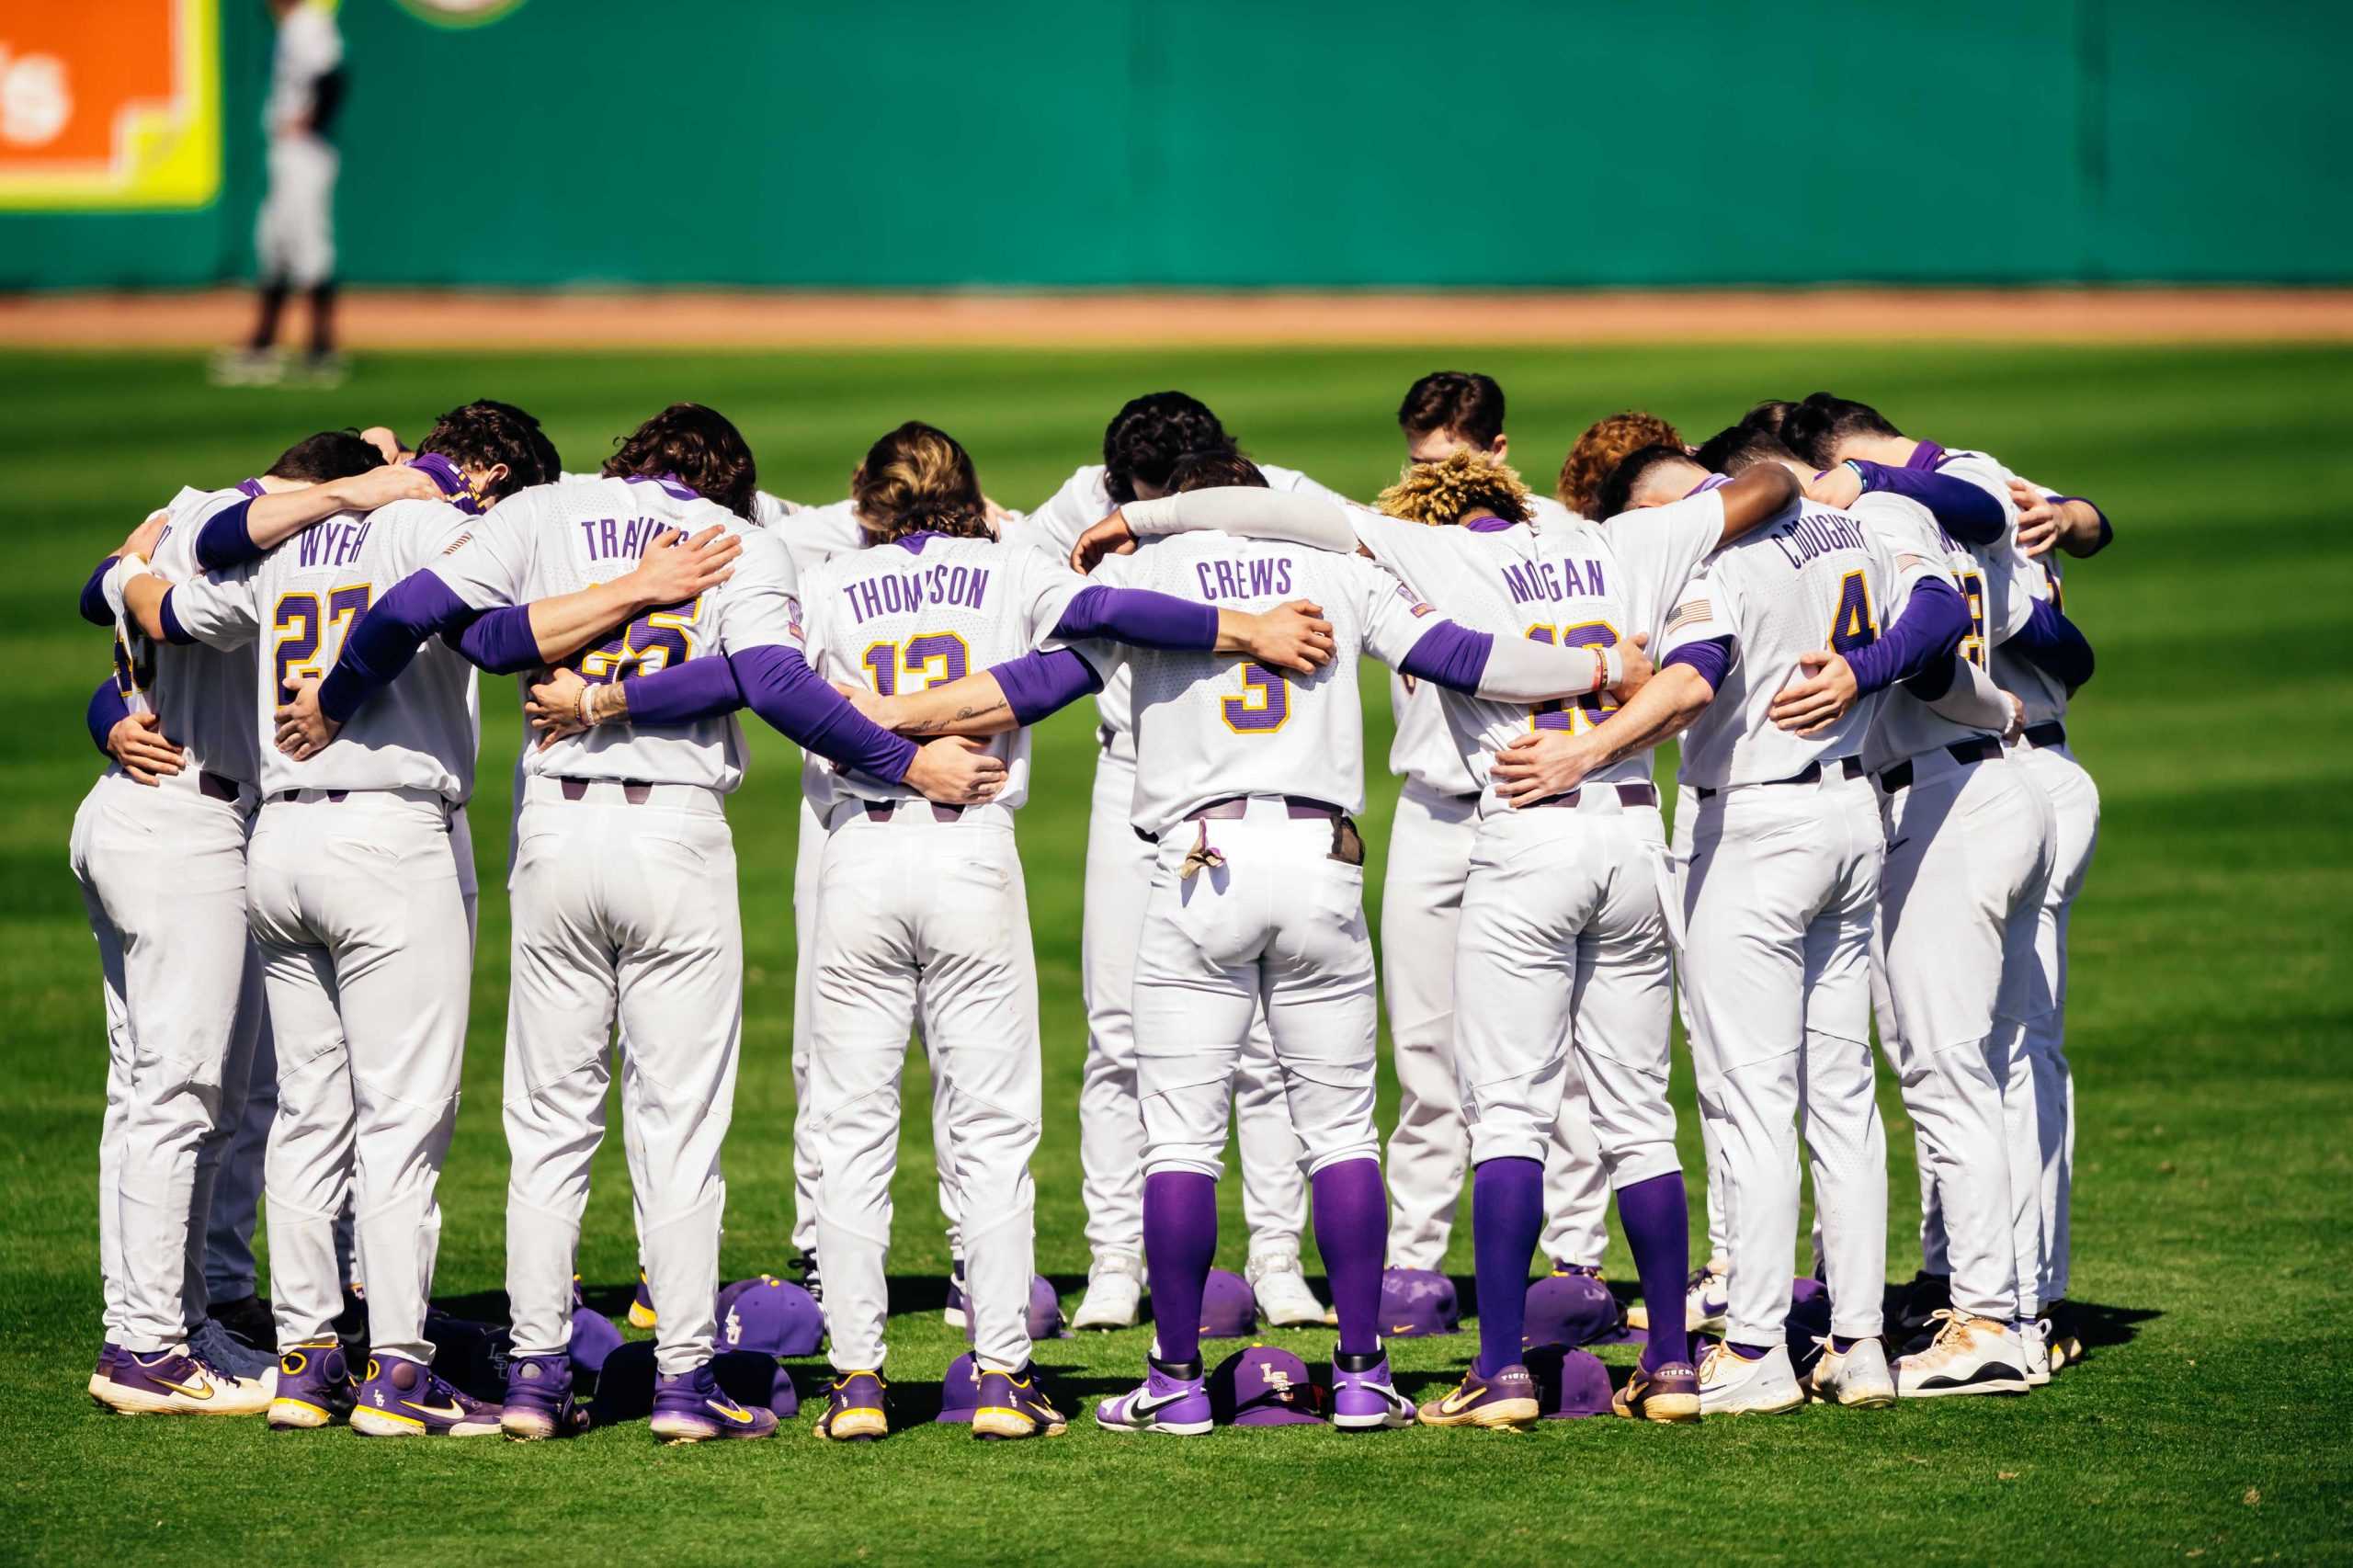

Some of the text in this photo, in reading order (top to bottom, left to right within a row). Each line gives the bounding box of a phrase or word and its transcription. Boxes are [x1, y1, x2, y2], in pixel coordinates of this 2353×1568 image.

[843, 564, 989, 624] THOMSON
[1196, 558, 1291, 600] CREWS
[1501, 559, 1605, 604] MOGAN
[1828, 569, 1877, 655] 4
[273, 583, 371, 710] 27
[725, 1304, 742, 1345] LSU
